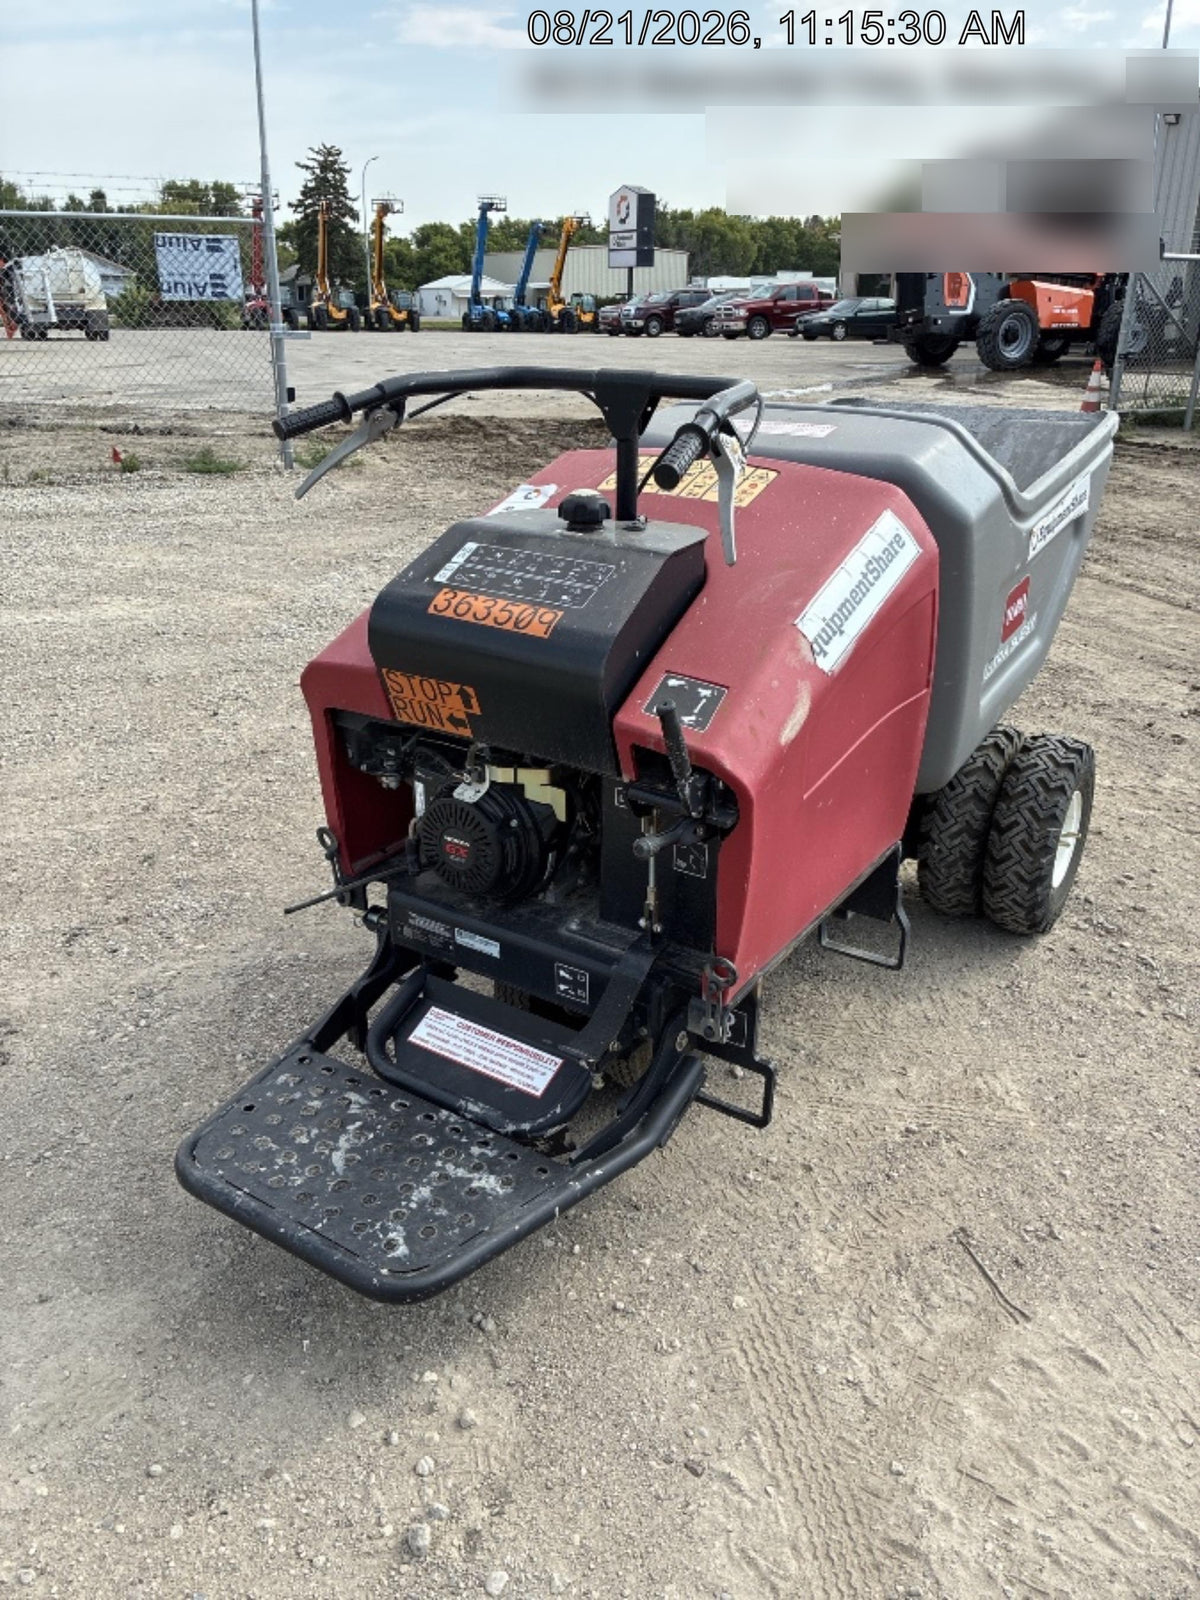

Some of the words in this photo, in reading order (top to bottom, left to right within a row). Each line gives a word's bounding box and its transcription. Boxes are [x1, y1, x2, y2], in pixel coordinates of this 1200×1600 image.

[433, 590, 559, 636] 363509
[386, 669, 453, 704] STOP
[393, 696, 446, 728] RUN
